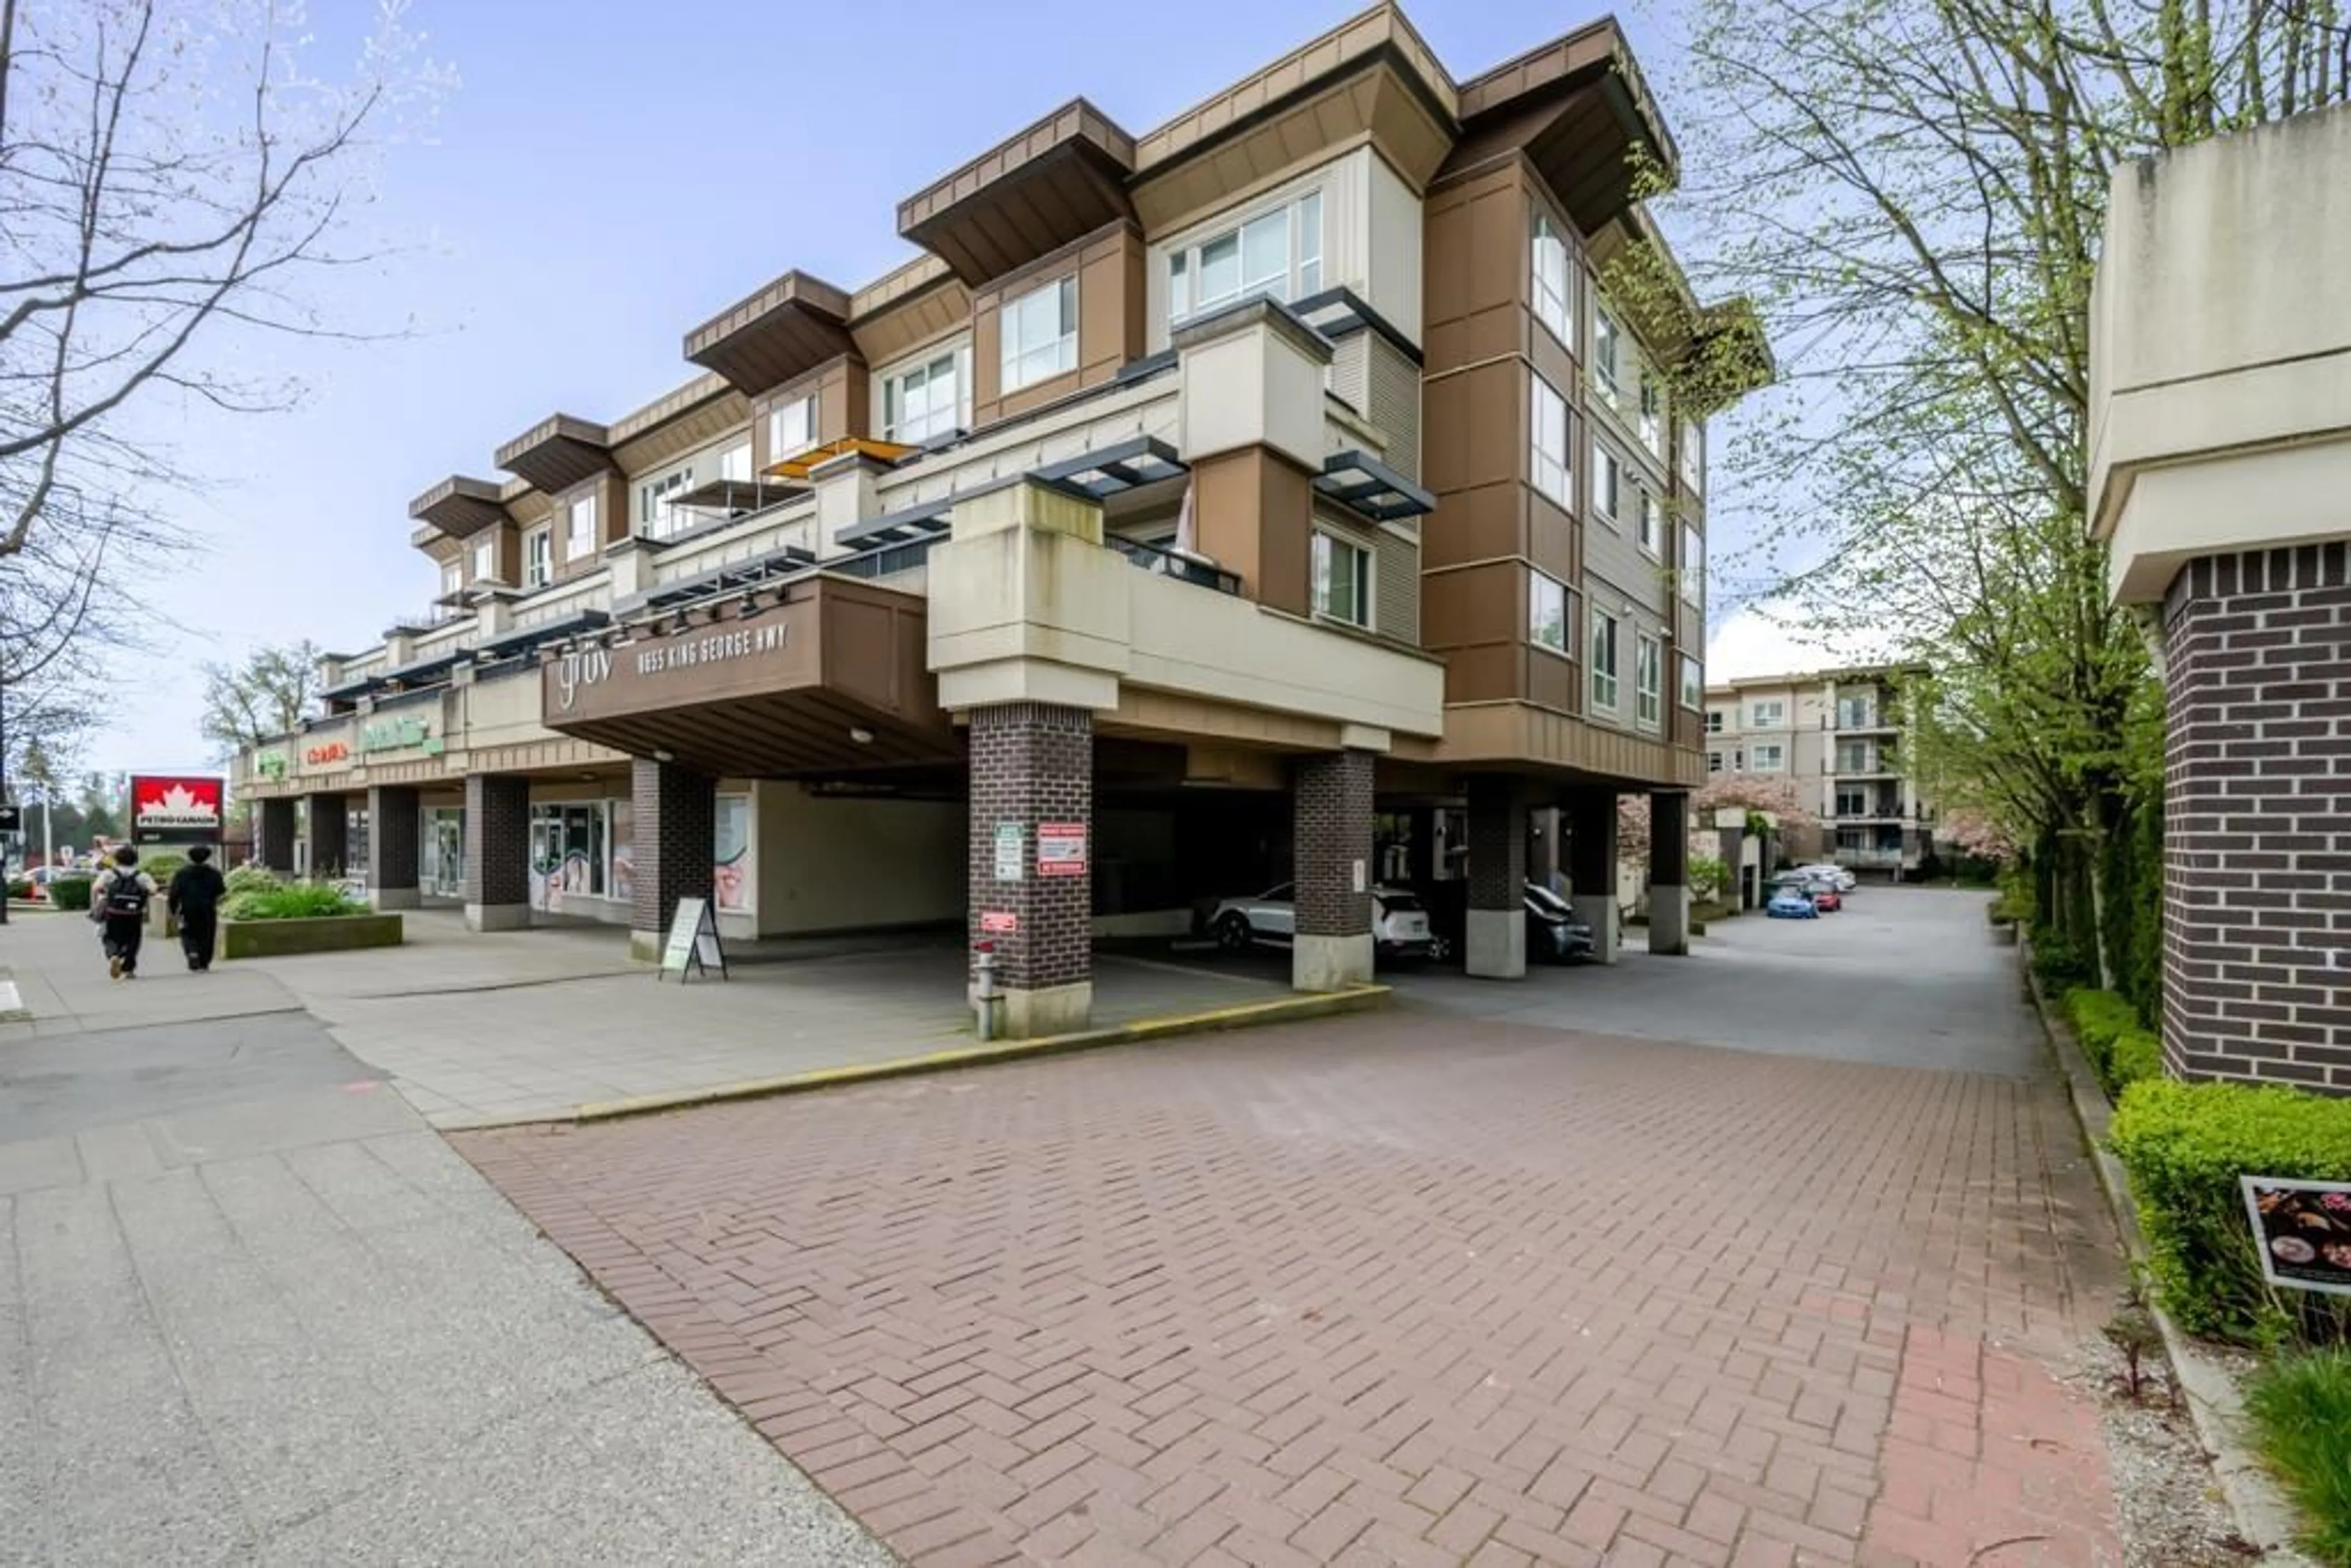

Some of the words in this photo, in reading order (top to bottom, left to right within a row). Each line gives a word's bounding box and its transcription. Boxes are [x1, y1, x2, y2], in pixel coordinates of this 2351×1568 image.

[668, 642, 696, 668] KING
[700, 629, 751, 662] GEORGE
[756, 623, 787, 651] HWY
